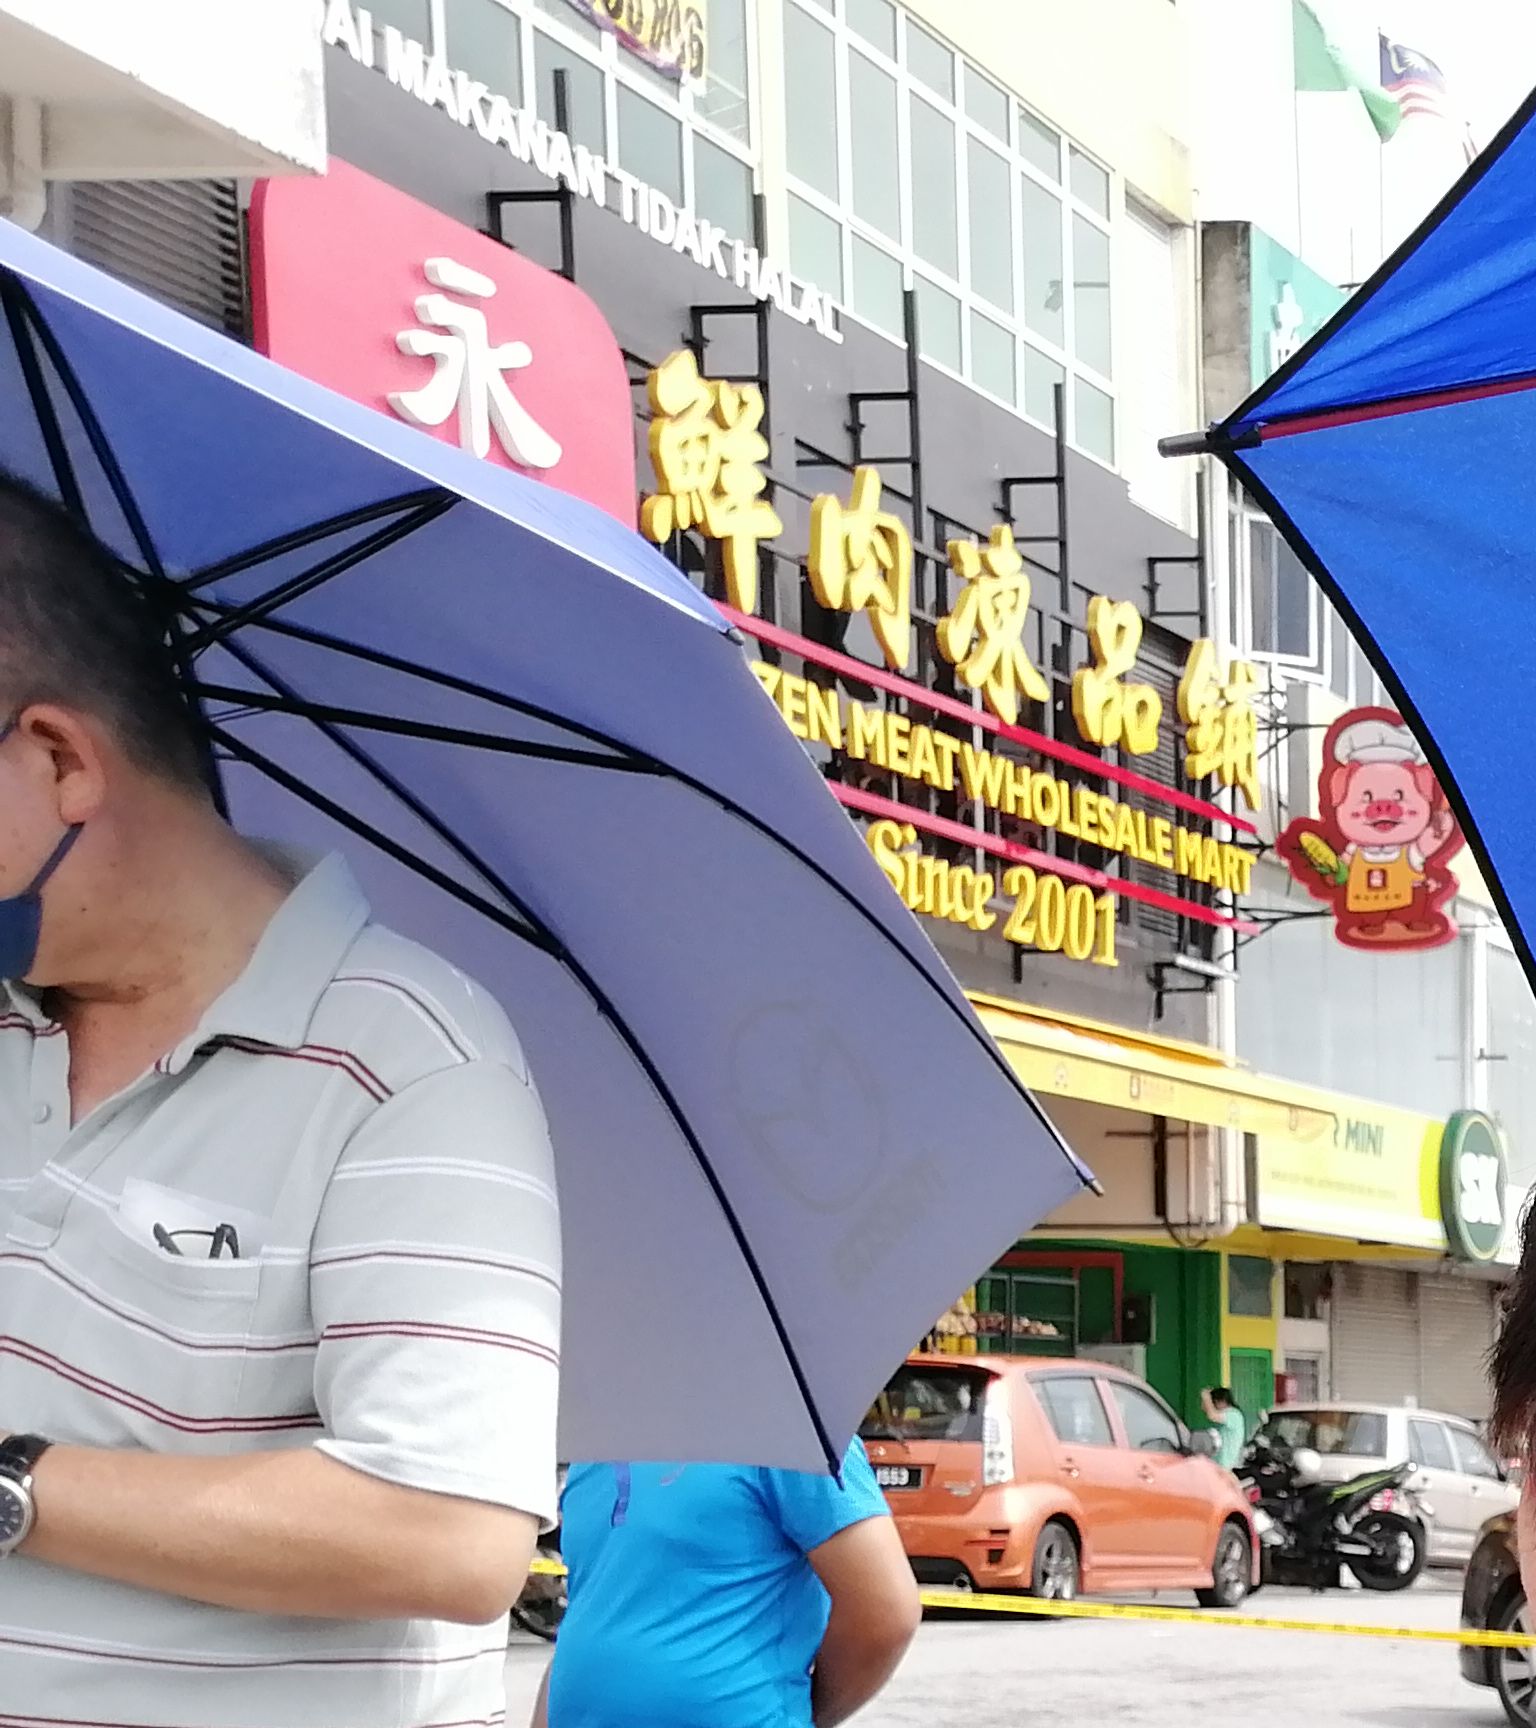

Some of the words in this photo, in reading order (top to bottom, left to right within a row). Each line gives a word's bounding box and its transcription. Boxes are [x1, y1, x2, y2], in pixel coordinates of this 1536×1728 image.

[384, 24, 606, 207] MAKANAN
[612, 167, 727, 278] TIDAK
[735, 239, 844, 345] HALAL
[386, 256, 562, 468] 永
[847, 700, 960, 791] MEAT
[958, 741, 1174, 869] WHOLESALE
[1174, 826, 1257, 895] MART
[866, 819, 997, 931] Since
[1003, 865, 1119, 967] 2001
[1345, 1118, 1384, 1157] MINI
